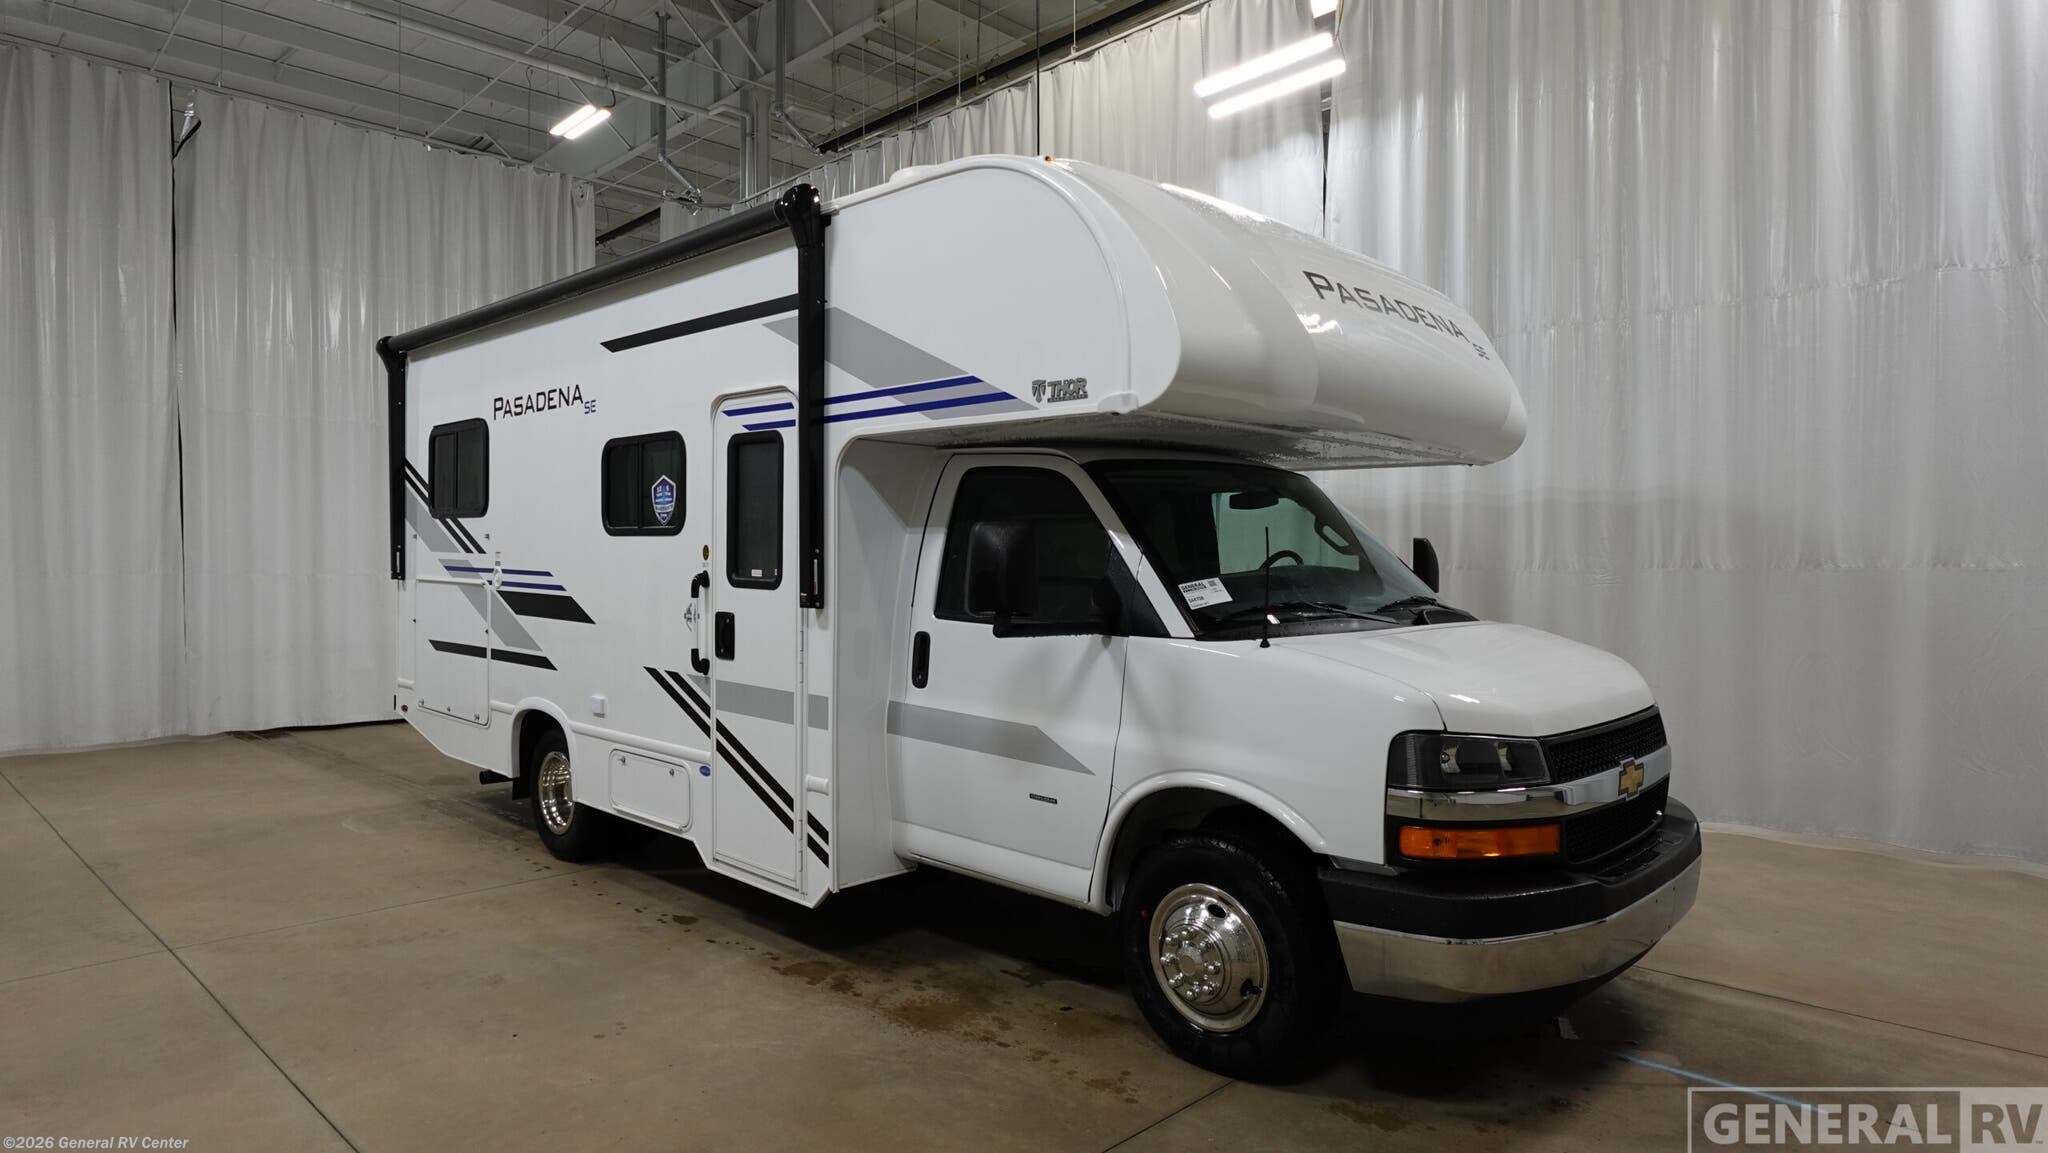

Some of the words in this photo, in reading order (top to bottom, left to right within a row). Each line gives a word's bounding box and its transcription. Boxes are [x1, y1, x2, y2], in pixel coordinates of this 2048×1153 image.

[1302, 270, 1470, 343] PASADENA
[493, 384, 583, 420] PASADENA
[584, 399, 597, 415] SE
[1047, 377, 1088, 398] THOR
